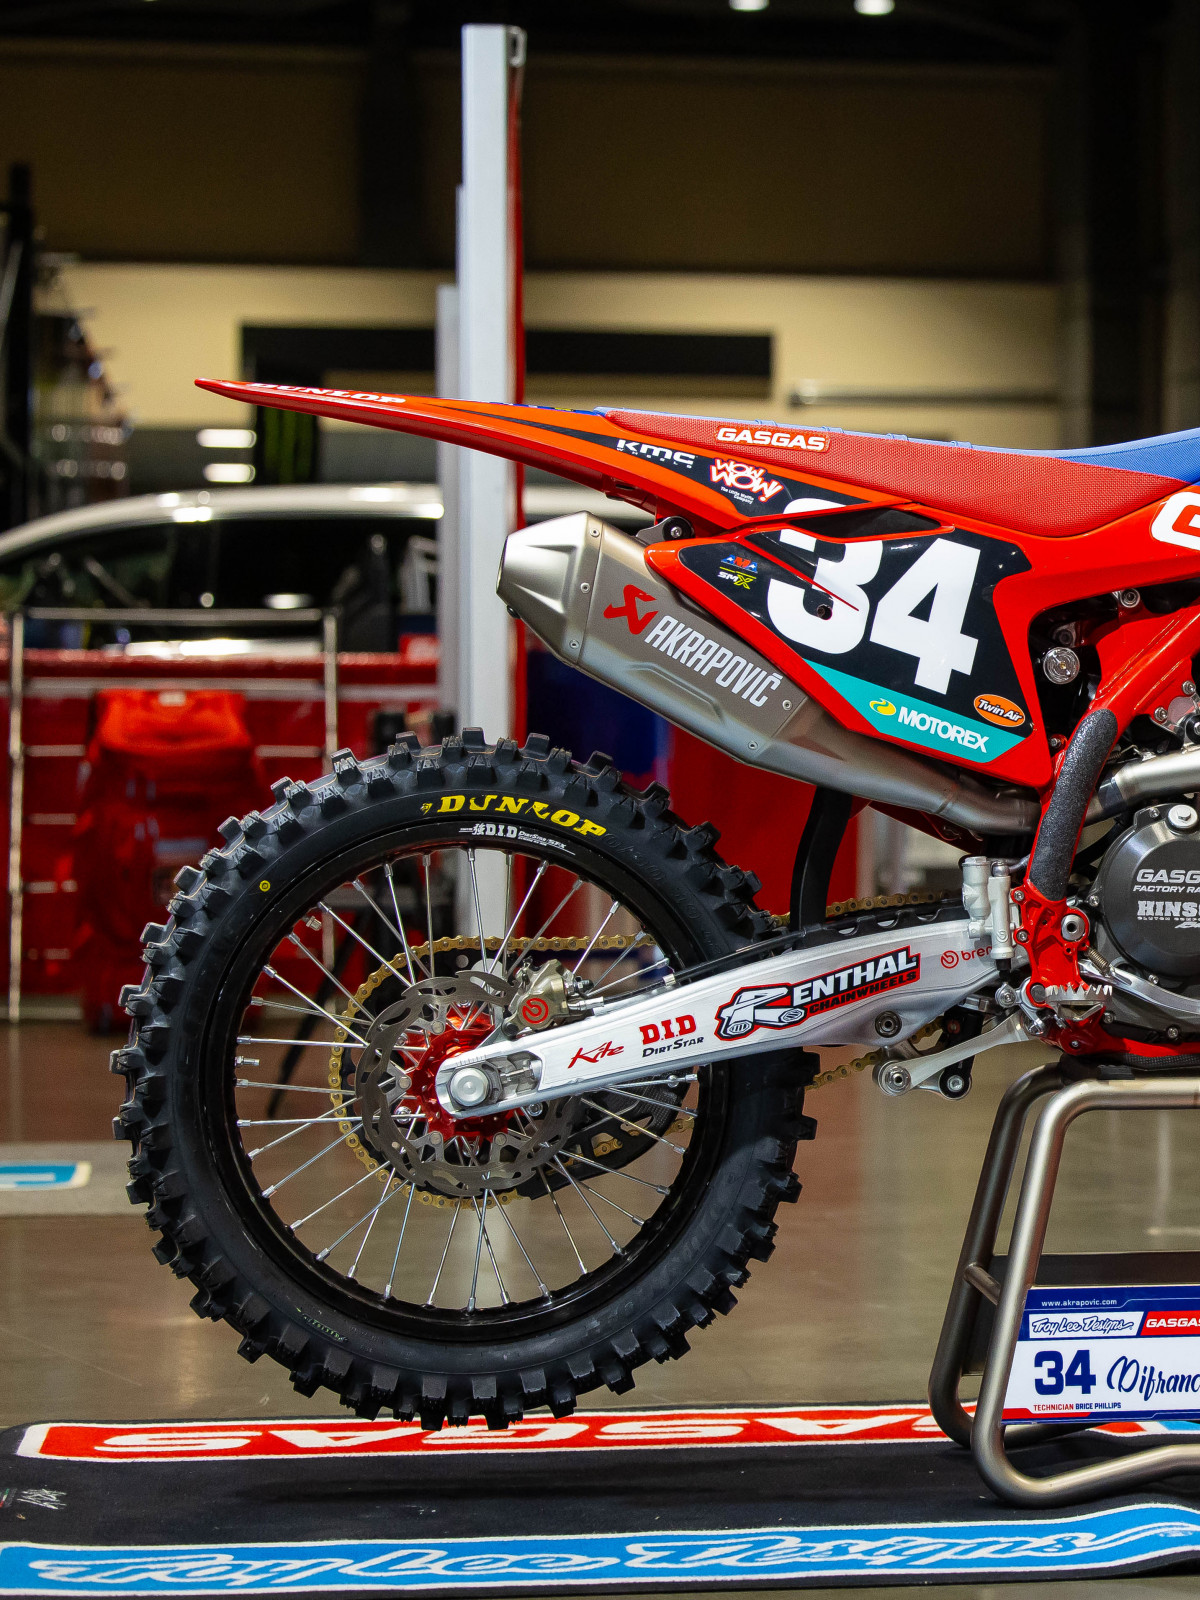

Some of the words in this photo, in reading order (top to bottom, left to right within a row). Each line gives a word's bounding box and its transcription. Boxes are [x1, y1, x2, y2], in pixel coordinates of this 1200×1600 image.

[247, 382, 406, 404] DUNLOP
[717, 427, 826, 450] GASGAS
[714, 458, 767, 479] WOW
[767, 497, 981, 695] 34
[978, 699, 1004, 717] Twin
[1003, 709, 1024, 723] Air
[898, 706, 990, 753] MOTOREX
[437, 794, 608, 838] DUNLOP
[1133, 885, 1185, 893] FACTORY
[718, 950, 918, 1037] RENTHAL
[810, 971, 918, 1014] CHAINWHEELS
[1041, 1298, 1118, 1308] www.akrapovic.com
[1031, 1317, 1060, 1336] Troy
[1058, 1317, 1082, 1333] Lee
[1082, 1315, 1134, 1335] Designs
[1034, 1349, 1097, 1396] 34
[1033, 1404, 1074, 1412] TECHNICIAN
[1075, 1403, 1094, 1411] BRICE
[1094, 1402, 1122, 1410] PHILLIPS
[30, 1553, 355, 1587] Troy
[342, 1548, 619, 1579] Lee
